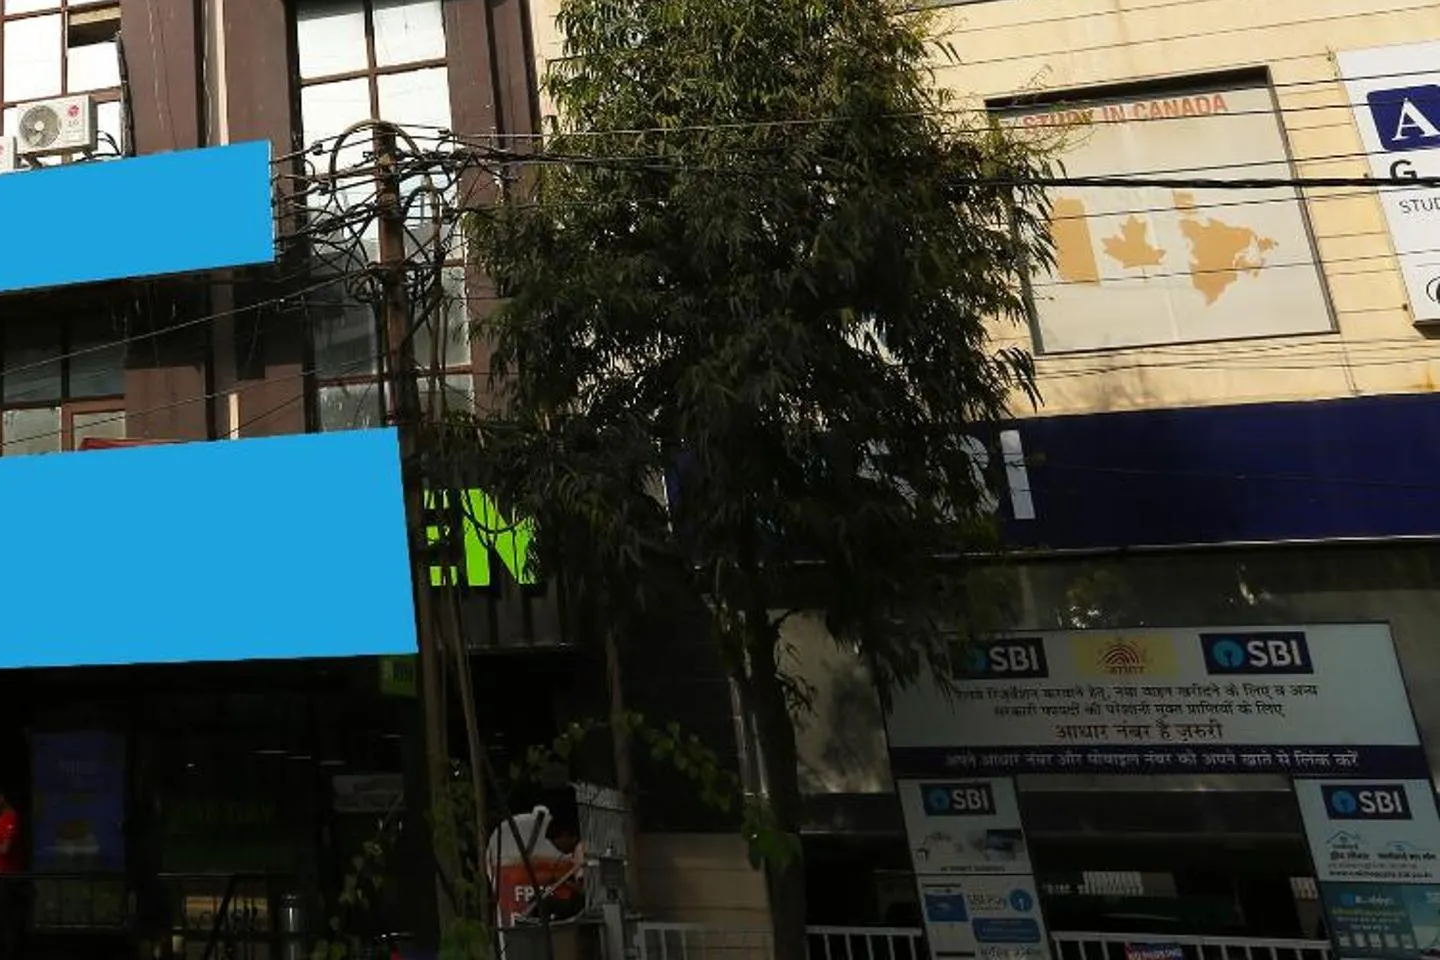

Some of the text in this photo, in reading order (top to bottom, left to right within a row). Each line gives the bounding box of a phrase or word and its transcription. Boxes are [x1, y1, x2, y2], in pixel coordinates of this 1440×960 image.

[1102, 103, 1126, 123] IN
[1132, 93, 1229, 120] CANADA
[988, 645, 1040, 673] SBI
[1246, 639, 1303, 667] SBI
[952, 787, 990, 811] SBI
[1358, 790, 1403, 814] SBI
